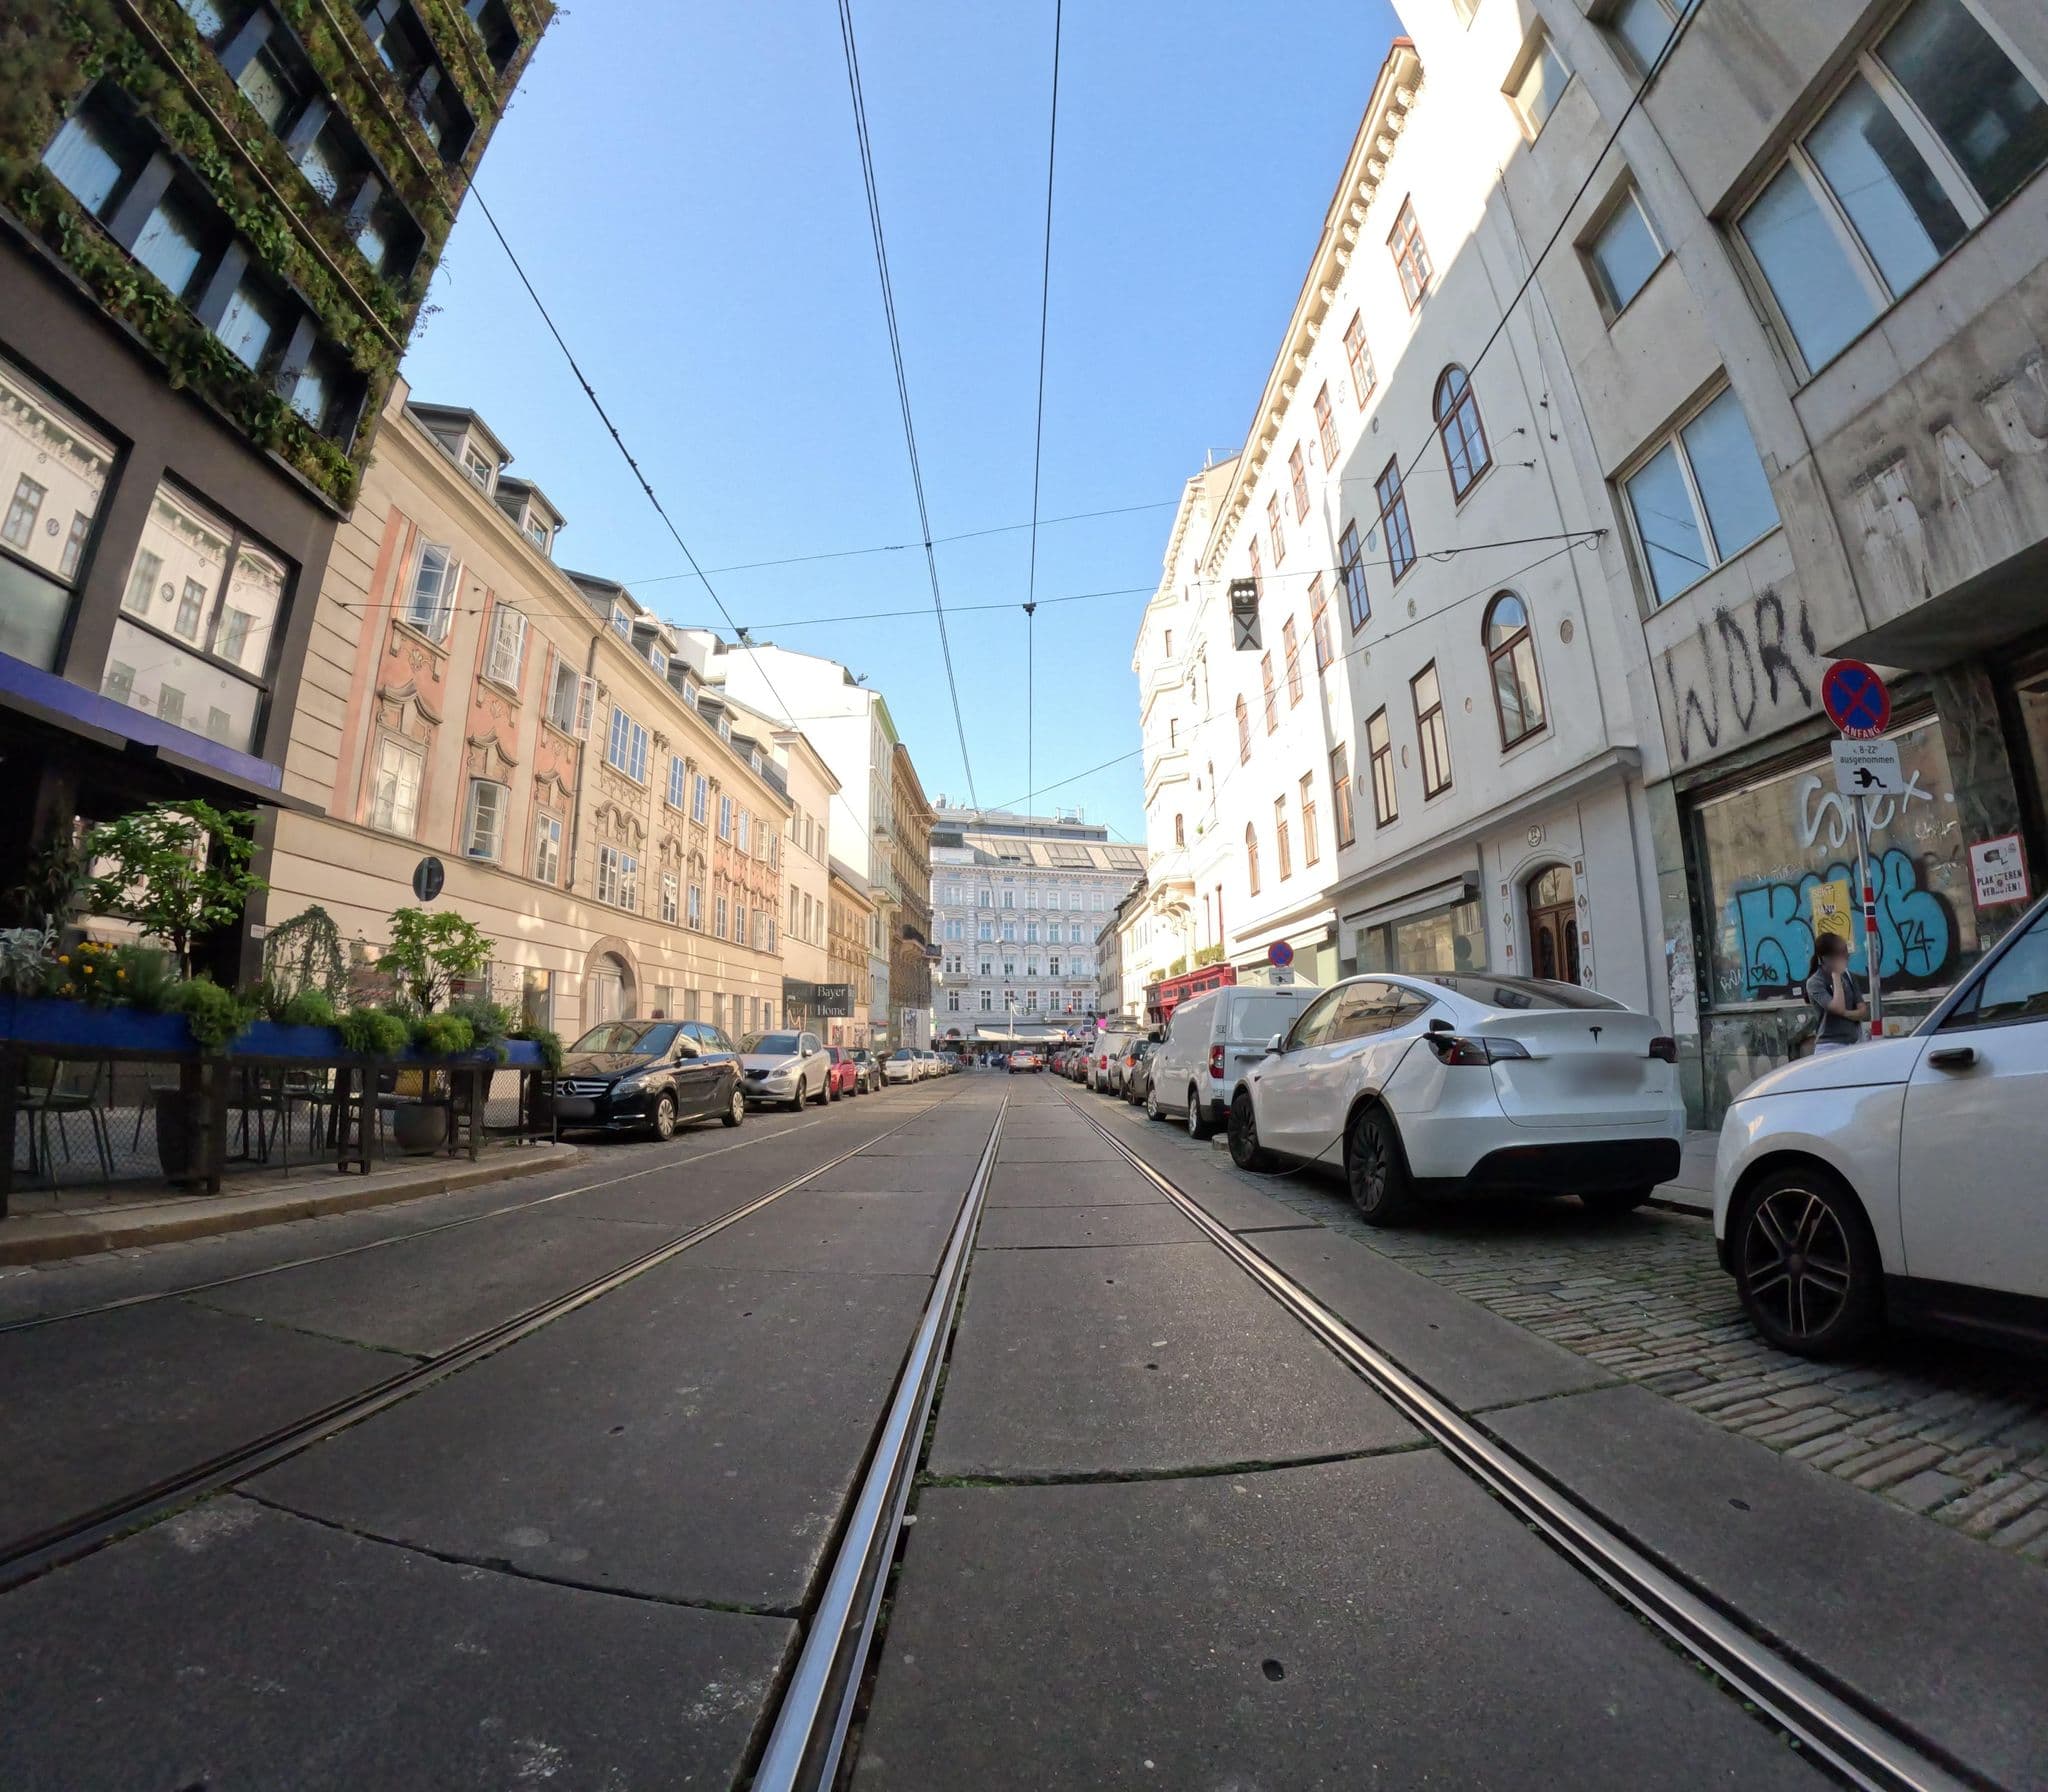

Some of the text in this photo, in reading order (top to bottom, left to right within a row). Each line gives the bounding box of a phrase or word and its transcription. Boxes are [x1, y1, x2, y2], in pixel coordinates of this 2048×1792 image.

[1843, 724, 1881, 738] ANFANG
[1840, 756, 1895, 765] ausgenommen
[817, 985, 846, 1000] Bayer
[817, 1004, 846, 1016] Home
